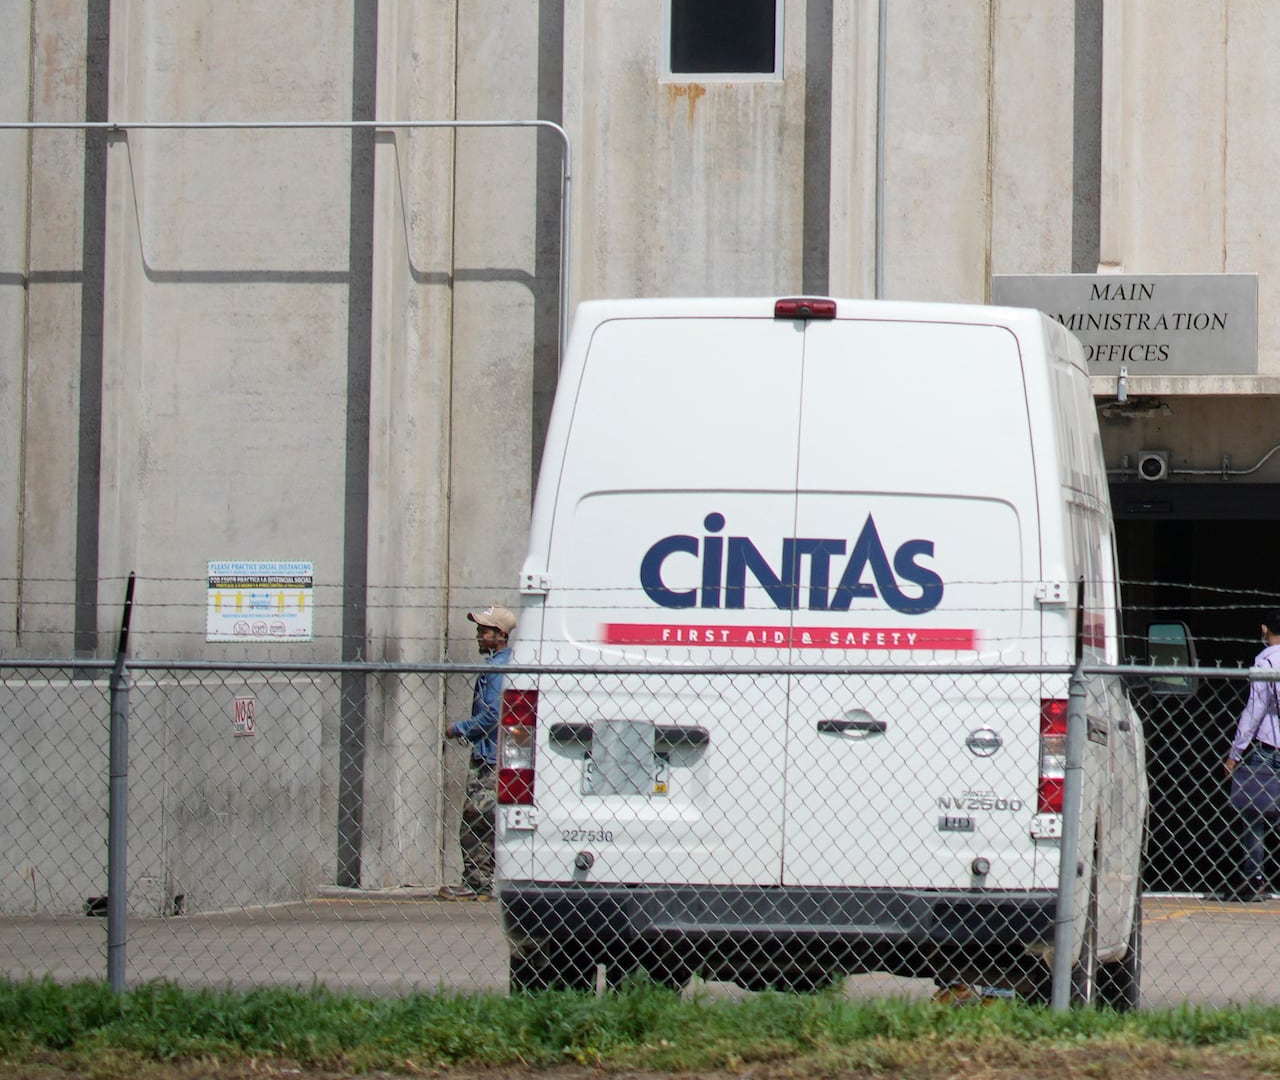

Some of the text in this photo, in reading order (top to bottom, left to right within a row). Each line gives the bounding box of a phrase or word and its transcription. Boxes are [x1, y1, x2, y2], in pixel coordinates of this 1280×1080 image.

[1090, 283, 1155, 301] MAIN
[1048, 312, 1228, 331] MINISTRATION
[662, 628, 918, 646] FIRST AID & SAFETY
[235, 701, 246, 723] NO
[937, 796, 1023, 812] NV2500
[944, 817, 970, 828] HD
[561, 829, 613, 842] 227530
